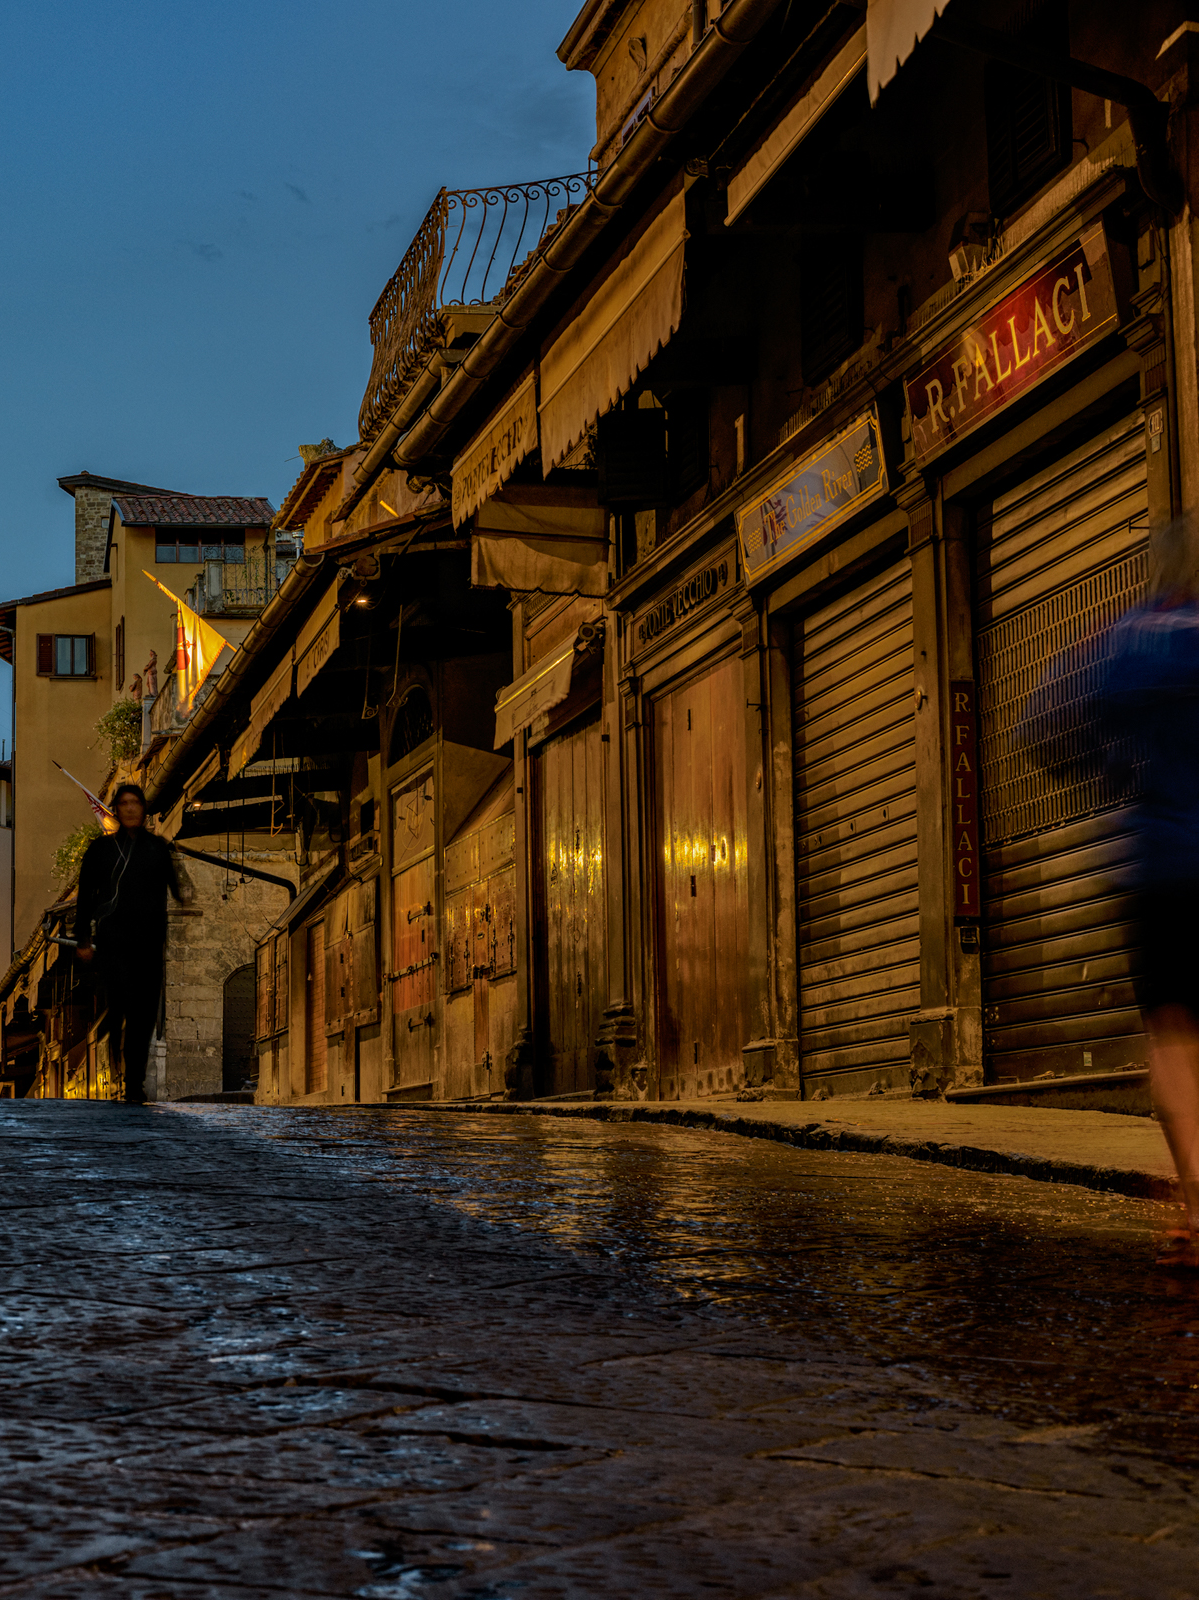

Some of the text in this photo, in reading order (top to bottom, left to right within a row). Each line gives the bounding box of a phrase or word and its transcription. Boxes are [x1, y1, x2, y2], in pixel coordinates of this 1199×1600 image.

[763, 468, 853, 544] The Golden River
[643, 568, 713, 638] PONTE VECCHIO
[955, 724, 974, 905] FALLACI
